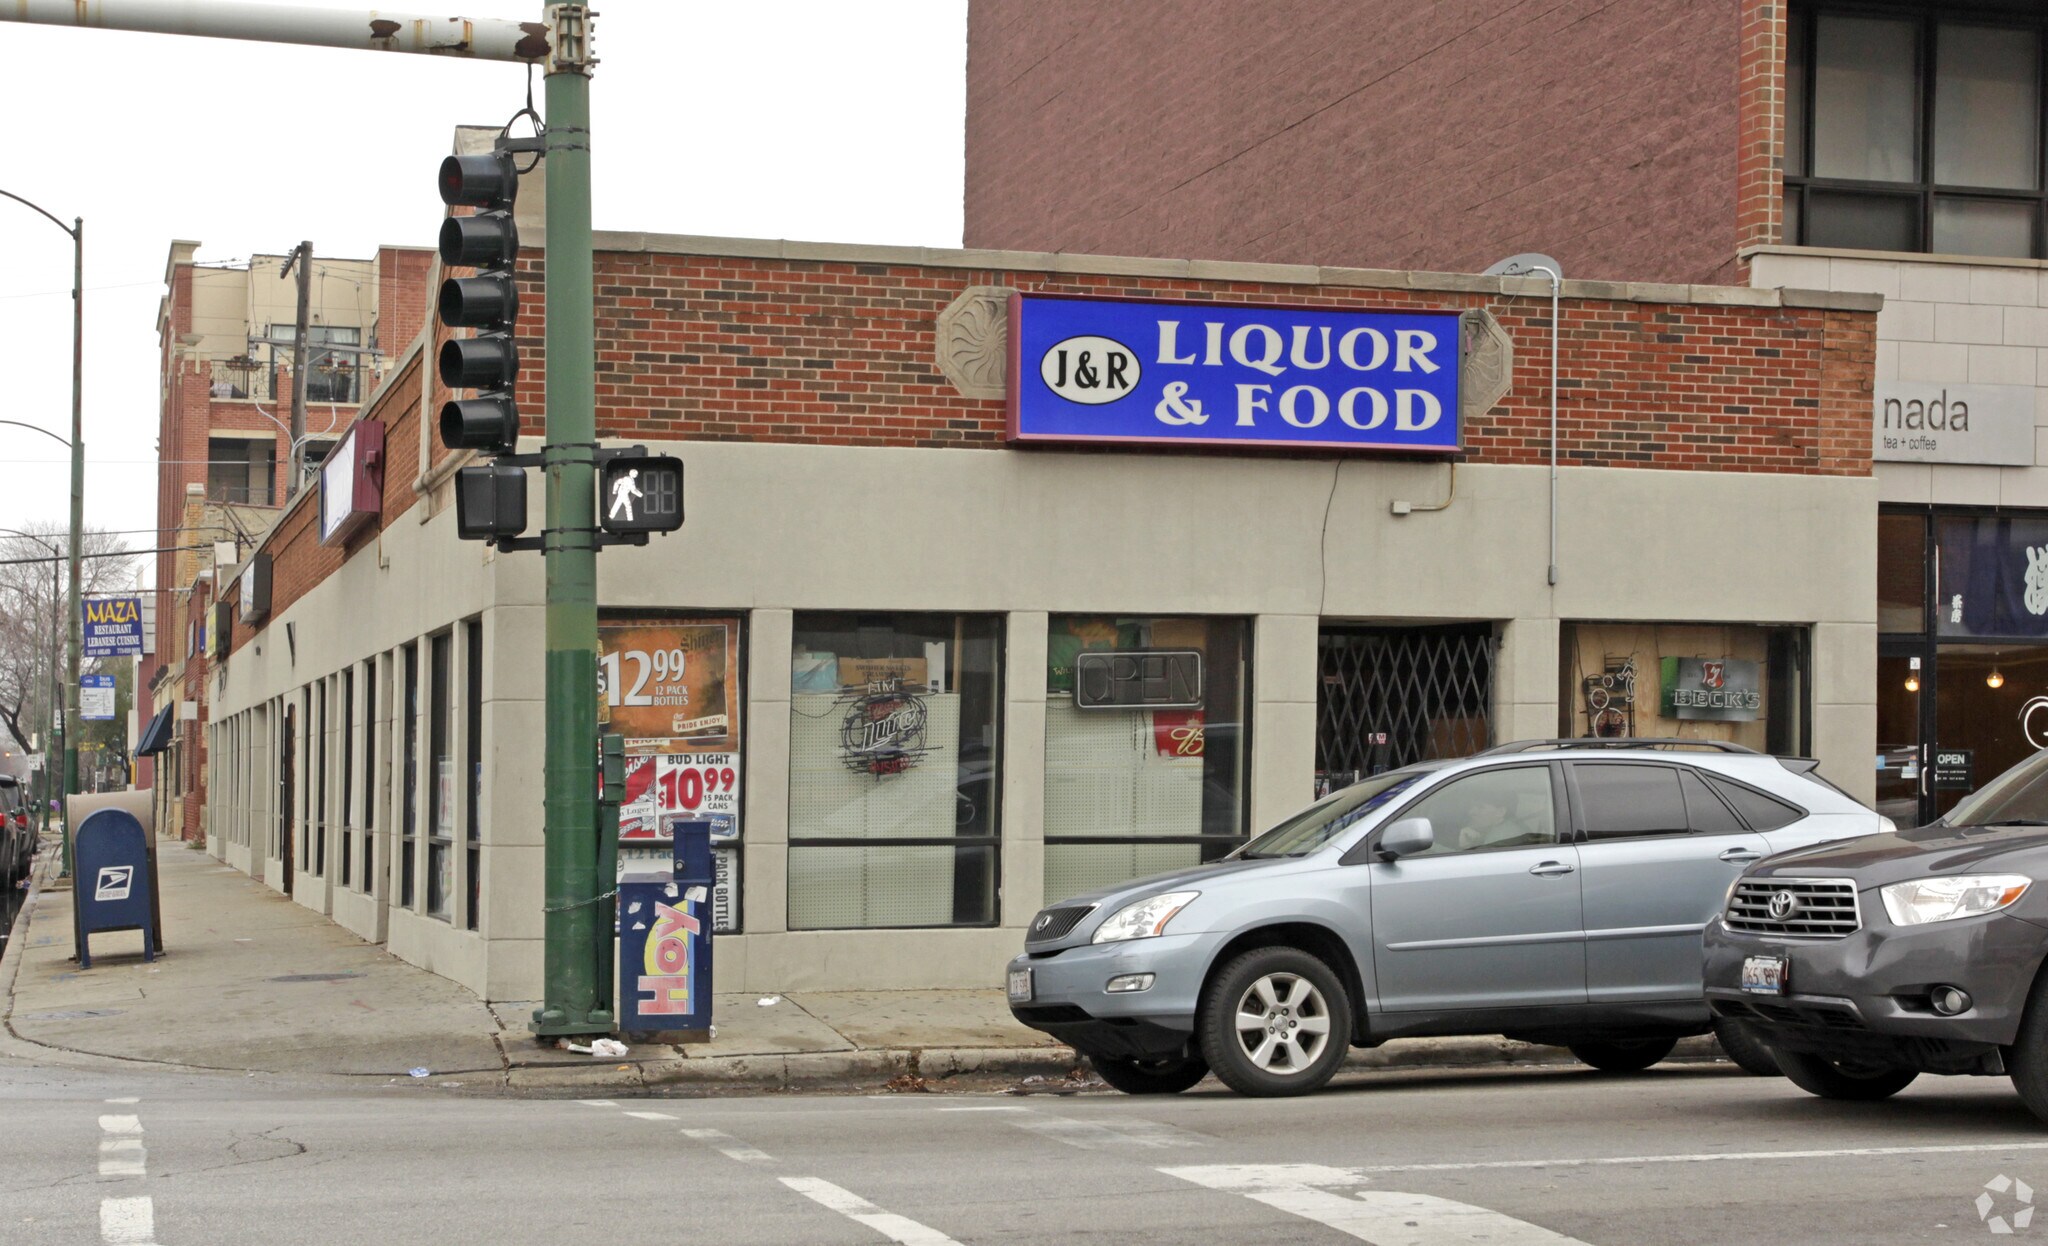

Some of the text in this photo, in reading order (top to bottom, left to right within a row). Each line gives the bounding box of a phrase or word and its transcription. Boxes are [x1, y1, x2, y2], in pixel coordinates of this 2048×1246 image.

[1156, 320, 1441, 376] LIQUOR
[1054, 350, 1129, 389] J&R
[1154, 381, 1442, 431] & FOOD
[1884, 389, 1969, 432] nada
[1884, 435, 1897, 449] tea
[1909, 436, 1937, 451] coffee
[87, 601, 138, 624] MAZA
[94, 624, 132, 635] RESTAURANT
[87, 635, 139, 647] LEBANESE CUISINE
[1083, 656, 1197, 701] OPEN
[655, 685, 688, 695] 12 PACK
[654, 696, 688, 705] BOTTLES
[1674, 689, 1760, 708] BECK'S
[677, 721, 698, 730] PRIDE
[667, 754, 730, 765] BUD LIGHT
[1937, 754, 1965, 764] OPEN
[707, 802, 729, 810] CANS
[715, 857, 729, 885] PACK
